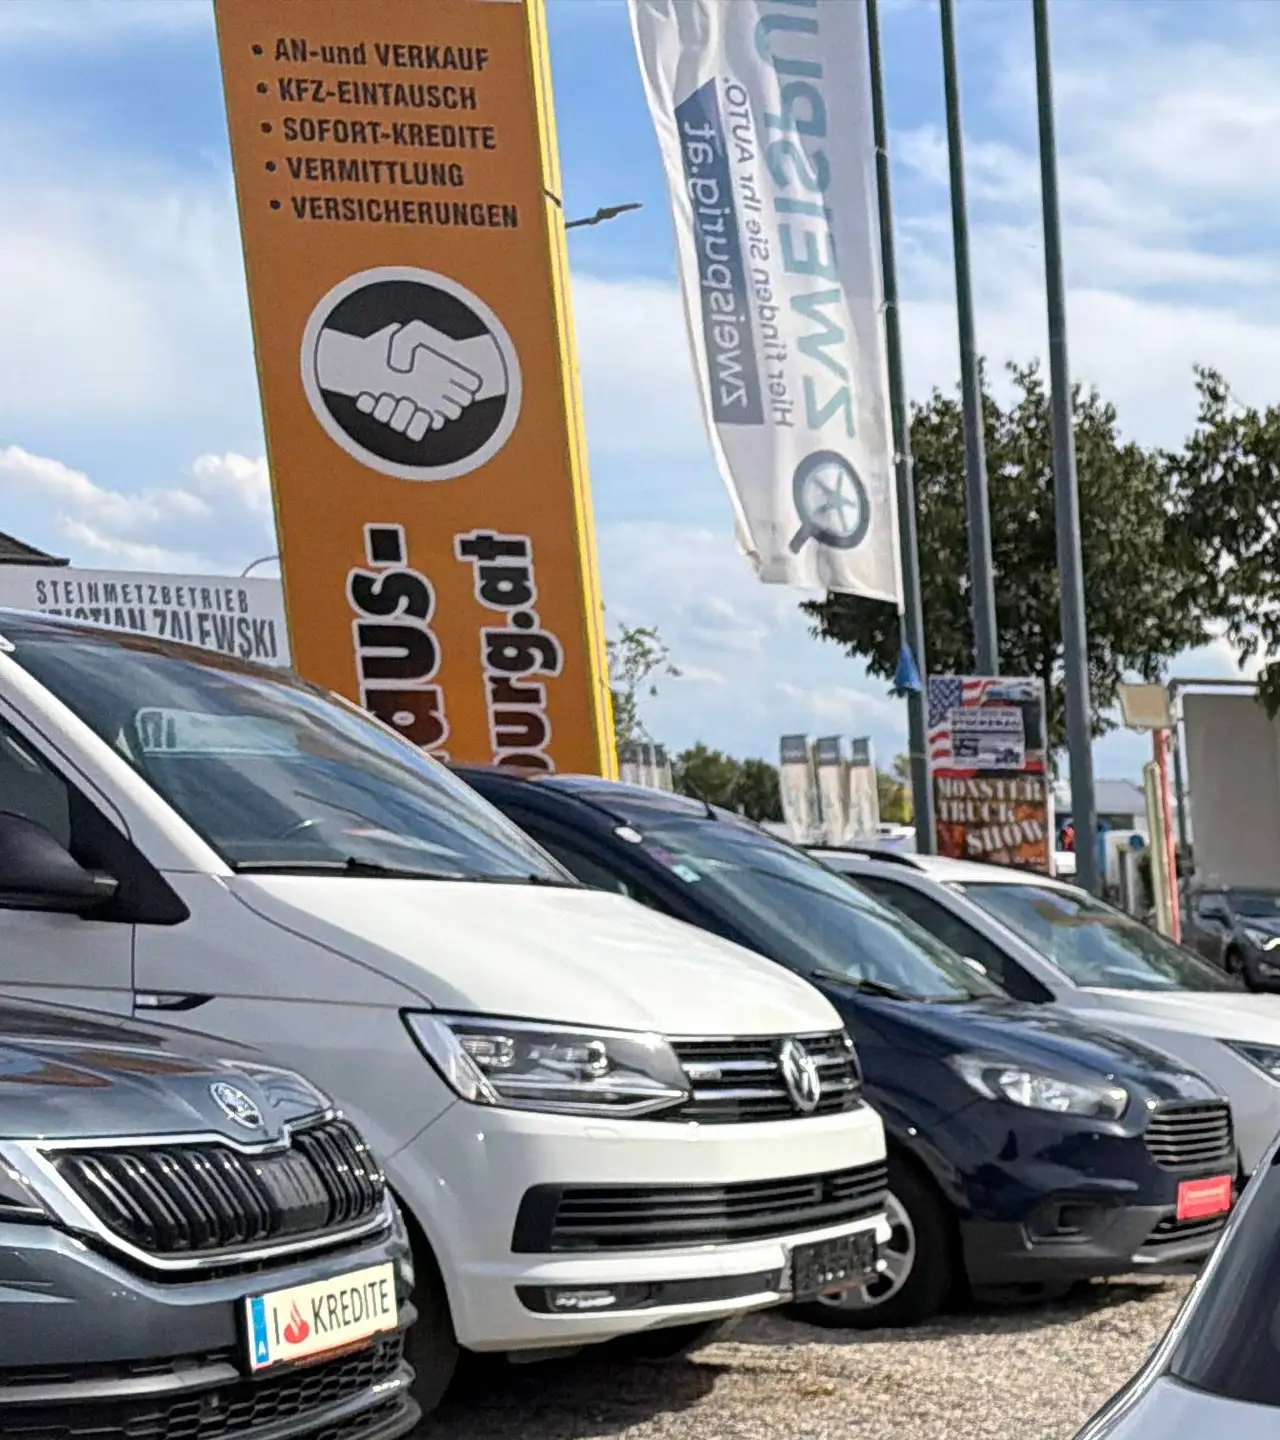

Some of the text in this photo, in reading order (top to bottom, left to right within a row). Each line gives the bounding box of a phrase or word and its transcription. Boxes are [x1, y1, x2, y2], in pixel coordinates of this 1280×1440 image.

[275, 37, 489, 71] AN-und VERKAUF
[279, 78, 477, 110] KFZ-EINTAUSCH
[284, 117, 498, 151] SOFORT-KREDITE
[286, 156, 464, 187] VERMITTLUNG
[292, 196, 519, 228] VERSICHERUNGEN
[36, 579, 248, 614] STEINMETZBETRIEB
[346, 524, 450, 768] aus-
[456, 531, 562, 771] urg.at
[937, 777, 1043, 801] MONSTER
[938, 799, 1016, 823] TRUCK
[966, 819, 1043, 857] SHOW
[311, 1278, 390, 1336] KREDITE
